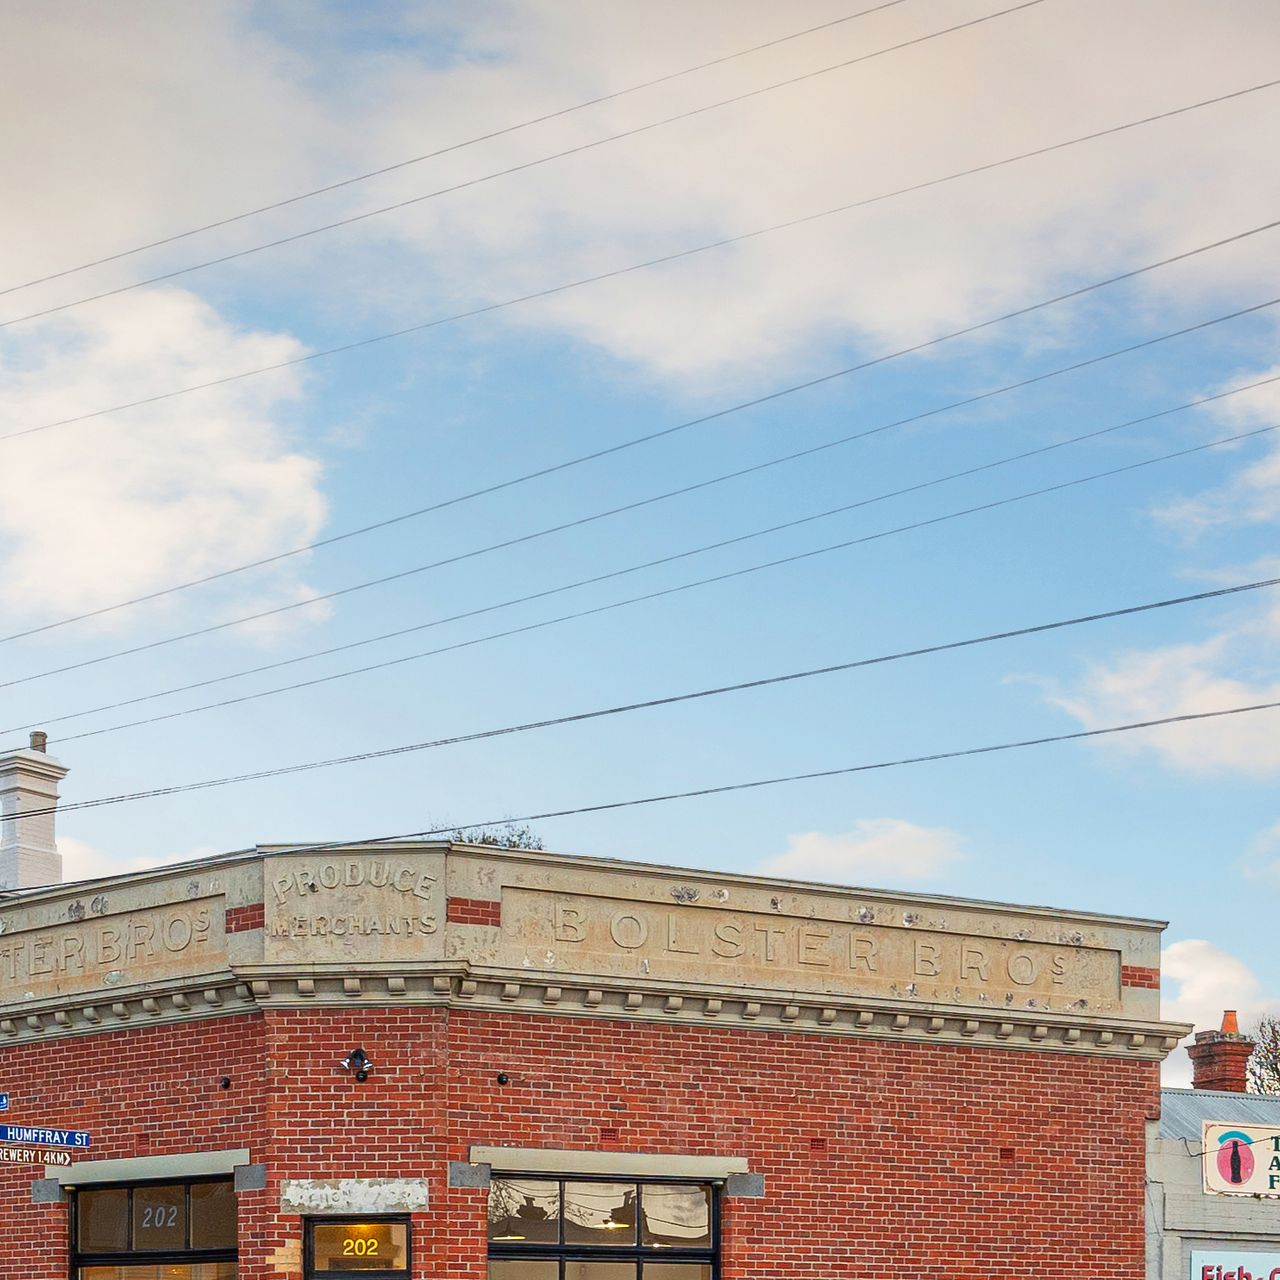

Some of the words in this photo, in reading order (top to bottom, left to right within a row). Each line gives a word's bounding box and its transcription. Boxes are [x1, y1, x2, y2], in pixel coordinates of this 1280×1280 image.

[272, 860, 437, 905] PRODUCE
[272, 914, 438, 937] MERCHANTS
[554, 902, 878, 973] BOLSTER
[7, 1127, 69, 1145] HUMFFRAY
[75, 1133, 88, 1146] ST
[37, 1151, 64, 1164] 1.4KM
[142, 1205, 178, 1228] 202
[342, 1238, 379, 1257] 202
